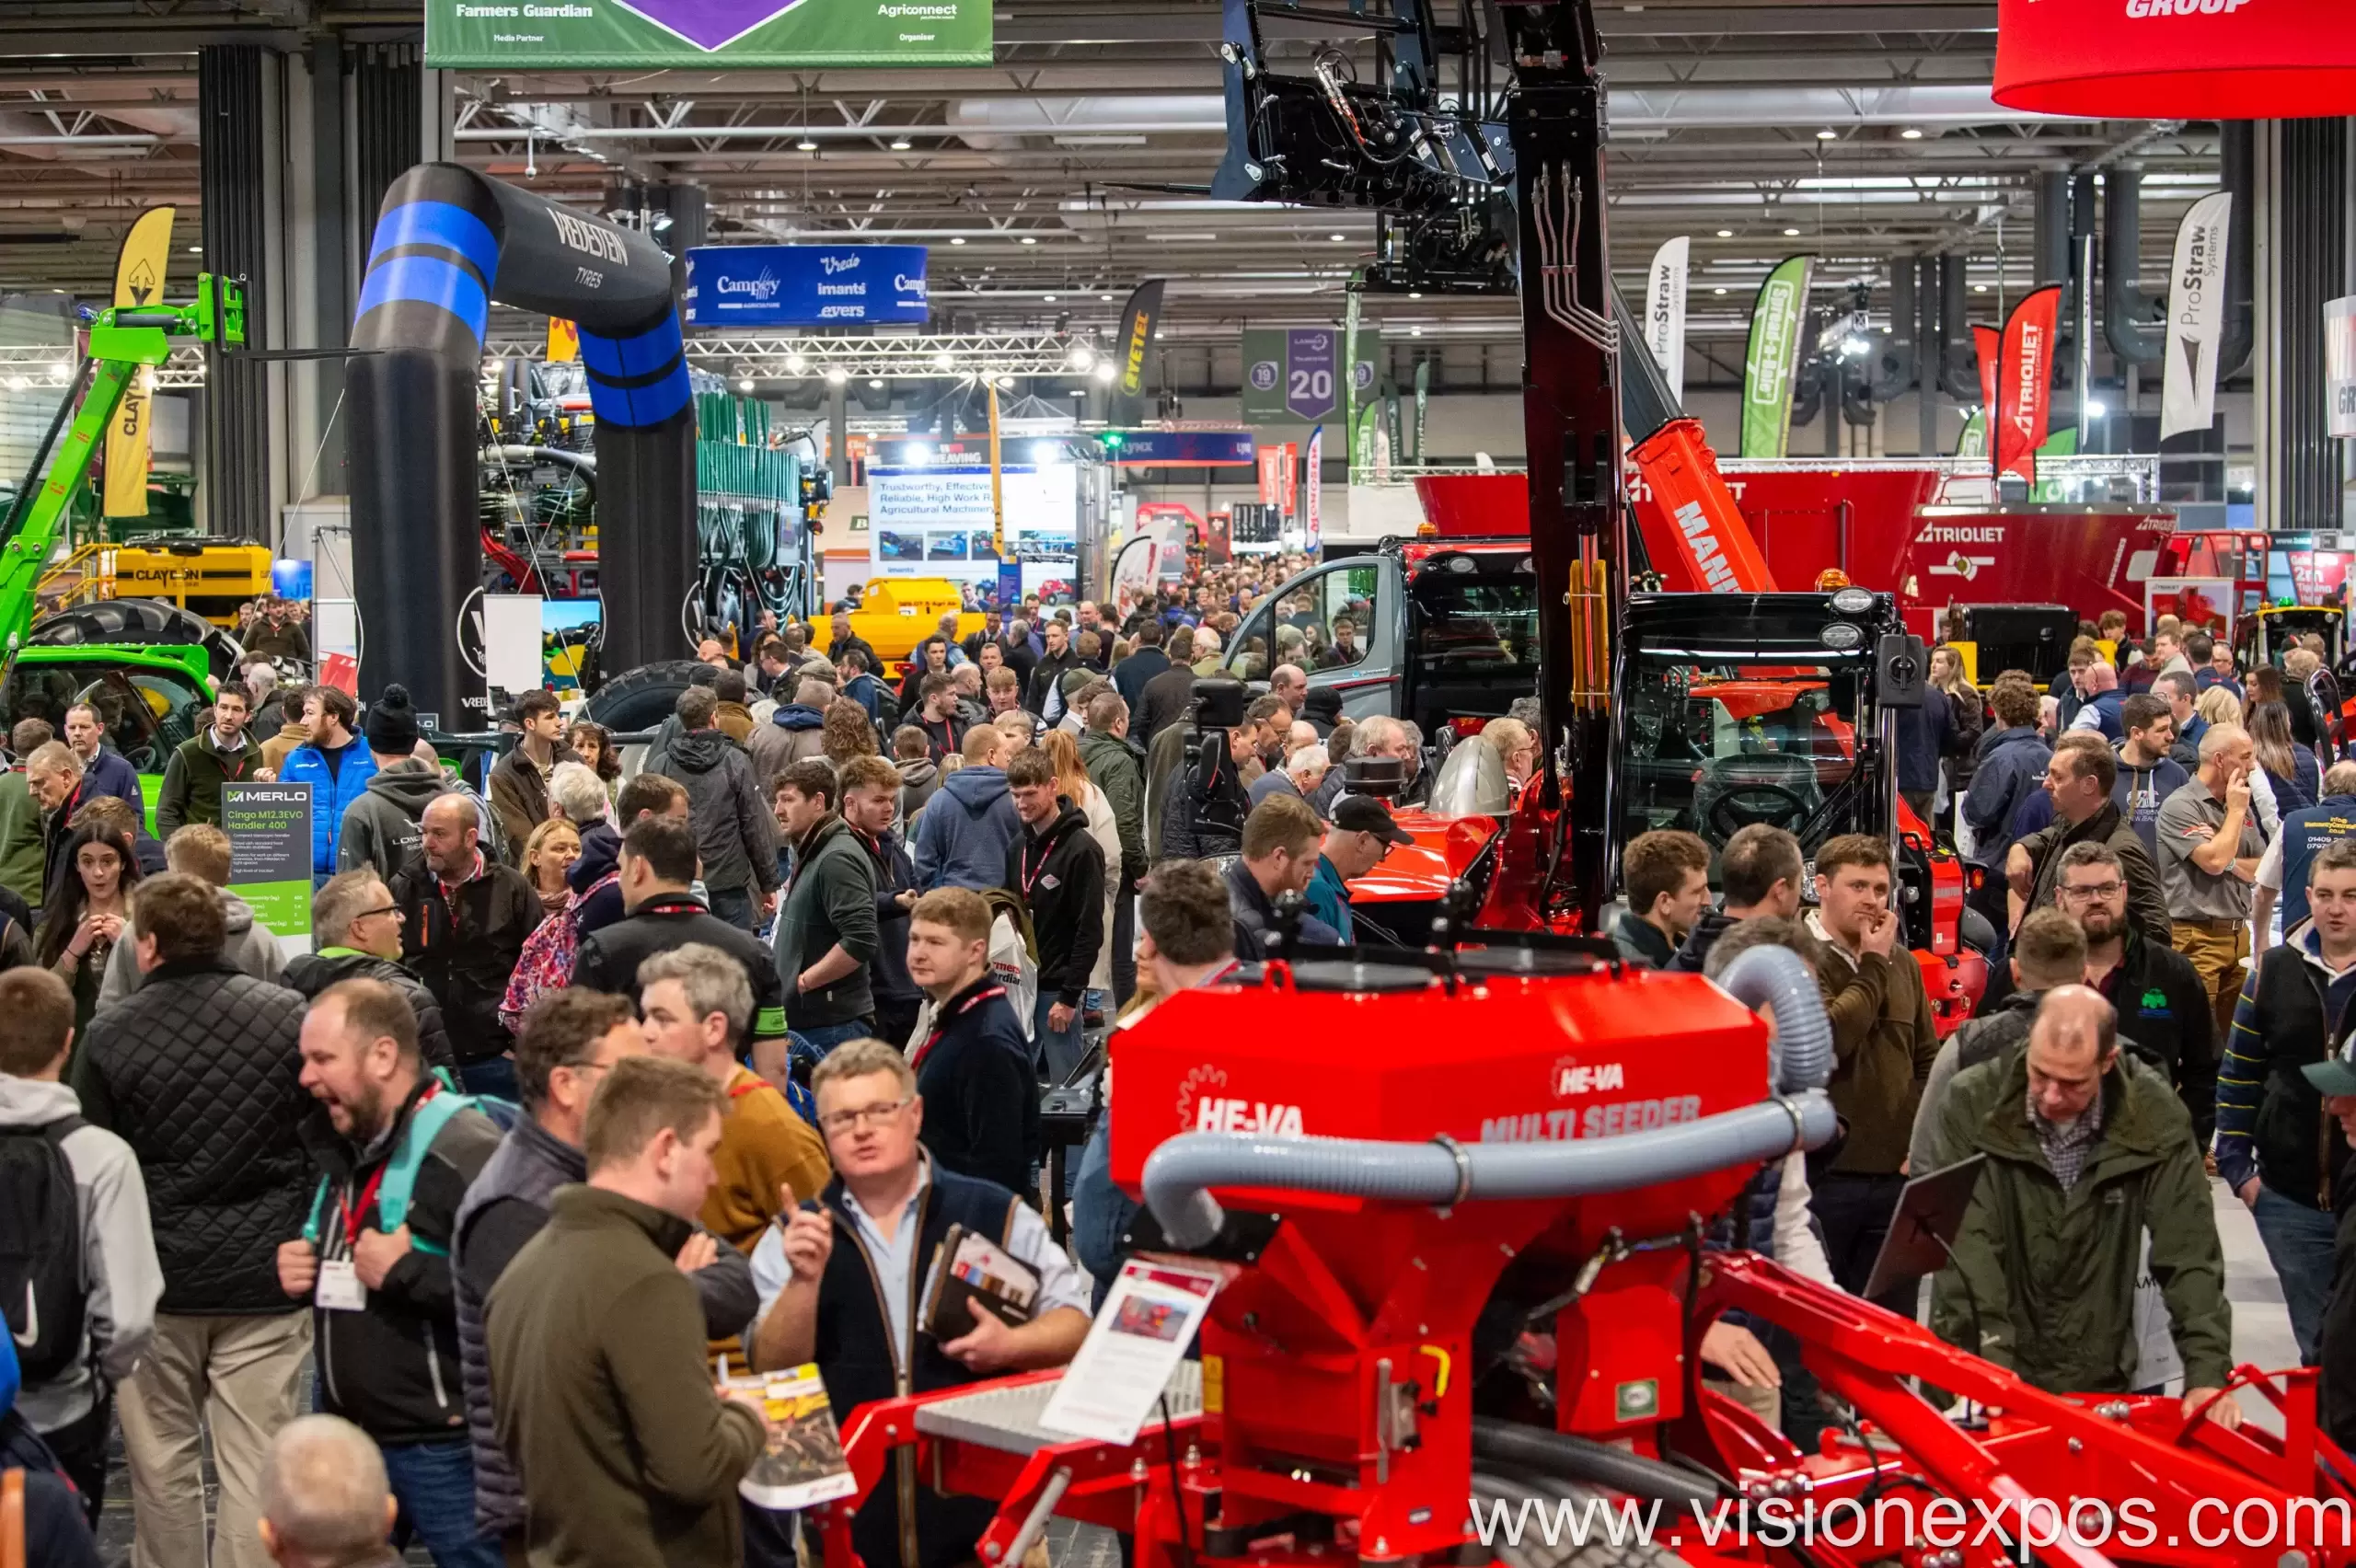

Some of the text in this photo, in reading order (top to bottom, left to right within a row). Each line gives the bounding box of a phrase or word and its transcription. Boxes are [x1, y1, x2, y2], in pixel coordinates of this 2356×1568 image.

[456, 4, 594, 17] Farmers Guardian
[877, 4, 958, 17] Agriconnect
[493, 34, 545, 42] Media Partner
[899, 33, 935, 42] Organiser
[2203, 225, 2219, 277] Systems
[574, 266, 604, 289] TYRES
[2180, 225, 2207, 326] ProStraw
[817, 282, 866, 295] imants
[1653, 264, 1671, 355] ProStraw
[1125, 308, 1149, 389] RYETEC
[2018, 321, 2038, 416] TRIOLIET
[1289, 370, 1333, 399] 20
[123, 365, 147, 436] CLAYD
[880, 482, 943, 492] Trustworthy,
[880, 493, 925, 503] Reliable,
[927, 493, 952, 503] High
[953, 493, 980, 502] Work
[880, 504, 940, 515] Agricultural
[1932, 526, 2006, 542] TRIOLIET
[246, 791, 307, 801] MERLO
[227, 811, 304, 821] Cingo M12.3EVO
[227, 821, 287, 829] Handler 400
[993, 961, 1021, 974] rmers
[1559, 1063, 1624, 1095] HE-VA
[1198, 1096, 1304, 1138] HE-VA
[1481, 1094, 1702, 1144] MULTI SEEDER
